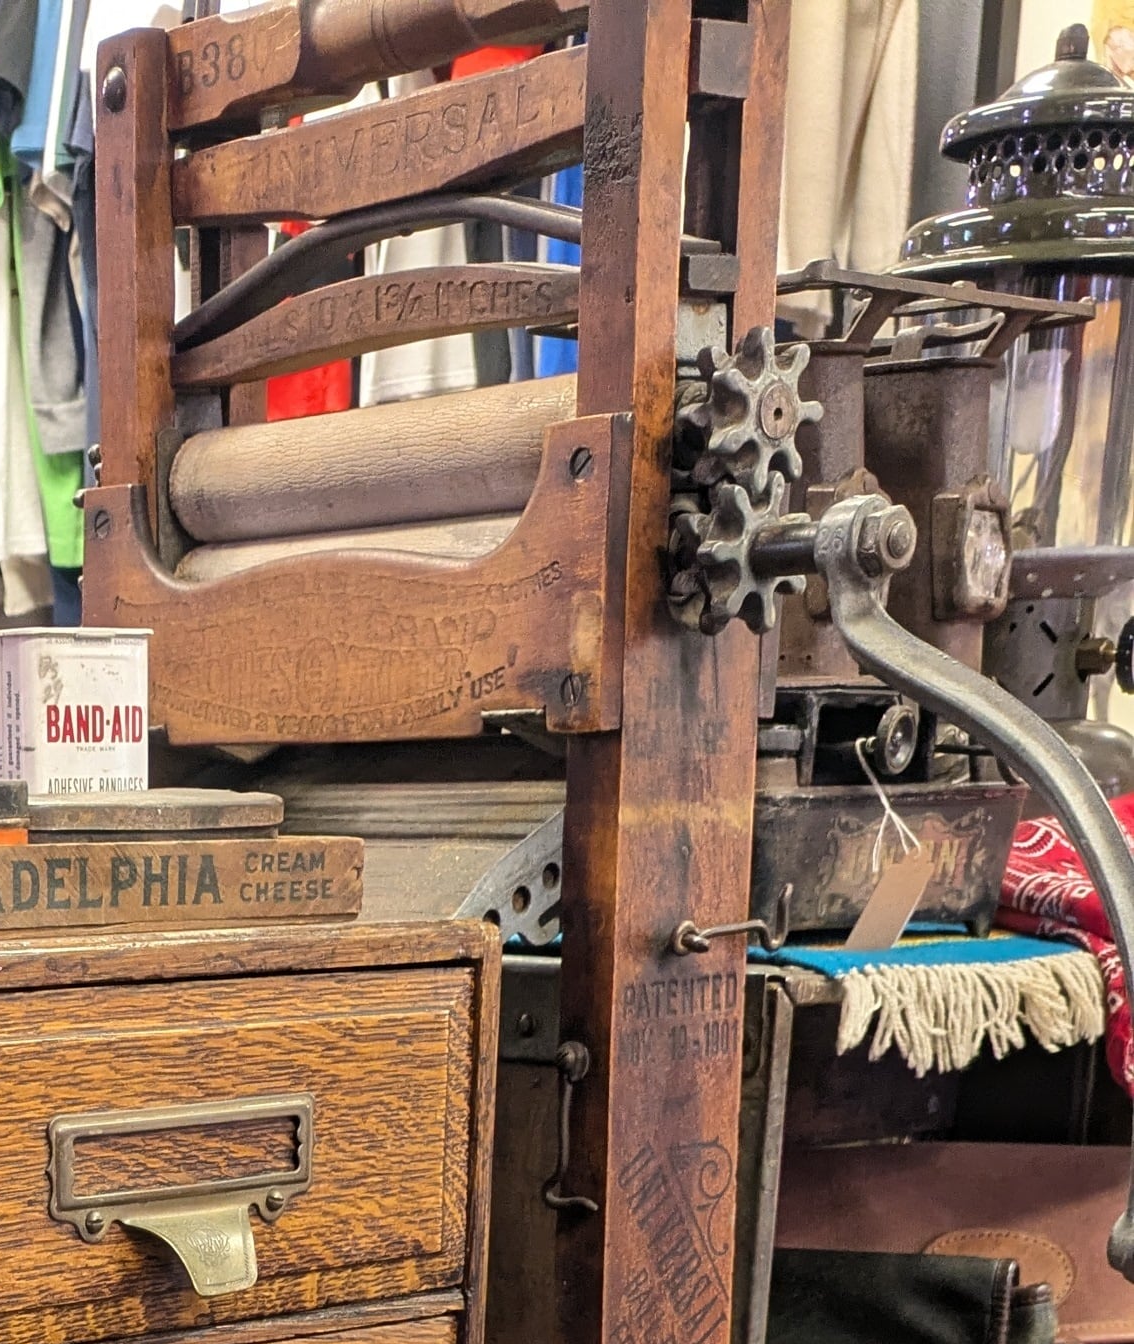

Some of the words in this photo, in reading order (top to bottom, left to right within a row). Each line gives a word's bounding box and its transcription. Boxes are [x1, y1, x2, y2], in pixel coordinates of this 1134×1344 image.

[434, 280, 554, 319] INCHES
[469, 665, 506, 699] USE
[244, 851, 326, 874] CREAM
[239, 878, 334, 903] CHEESE
[622, 970, 738, 1019] PATENTED
